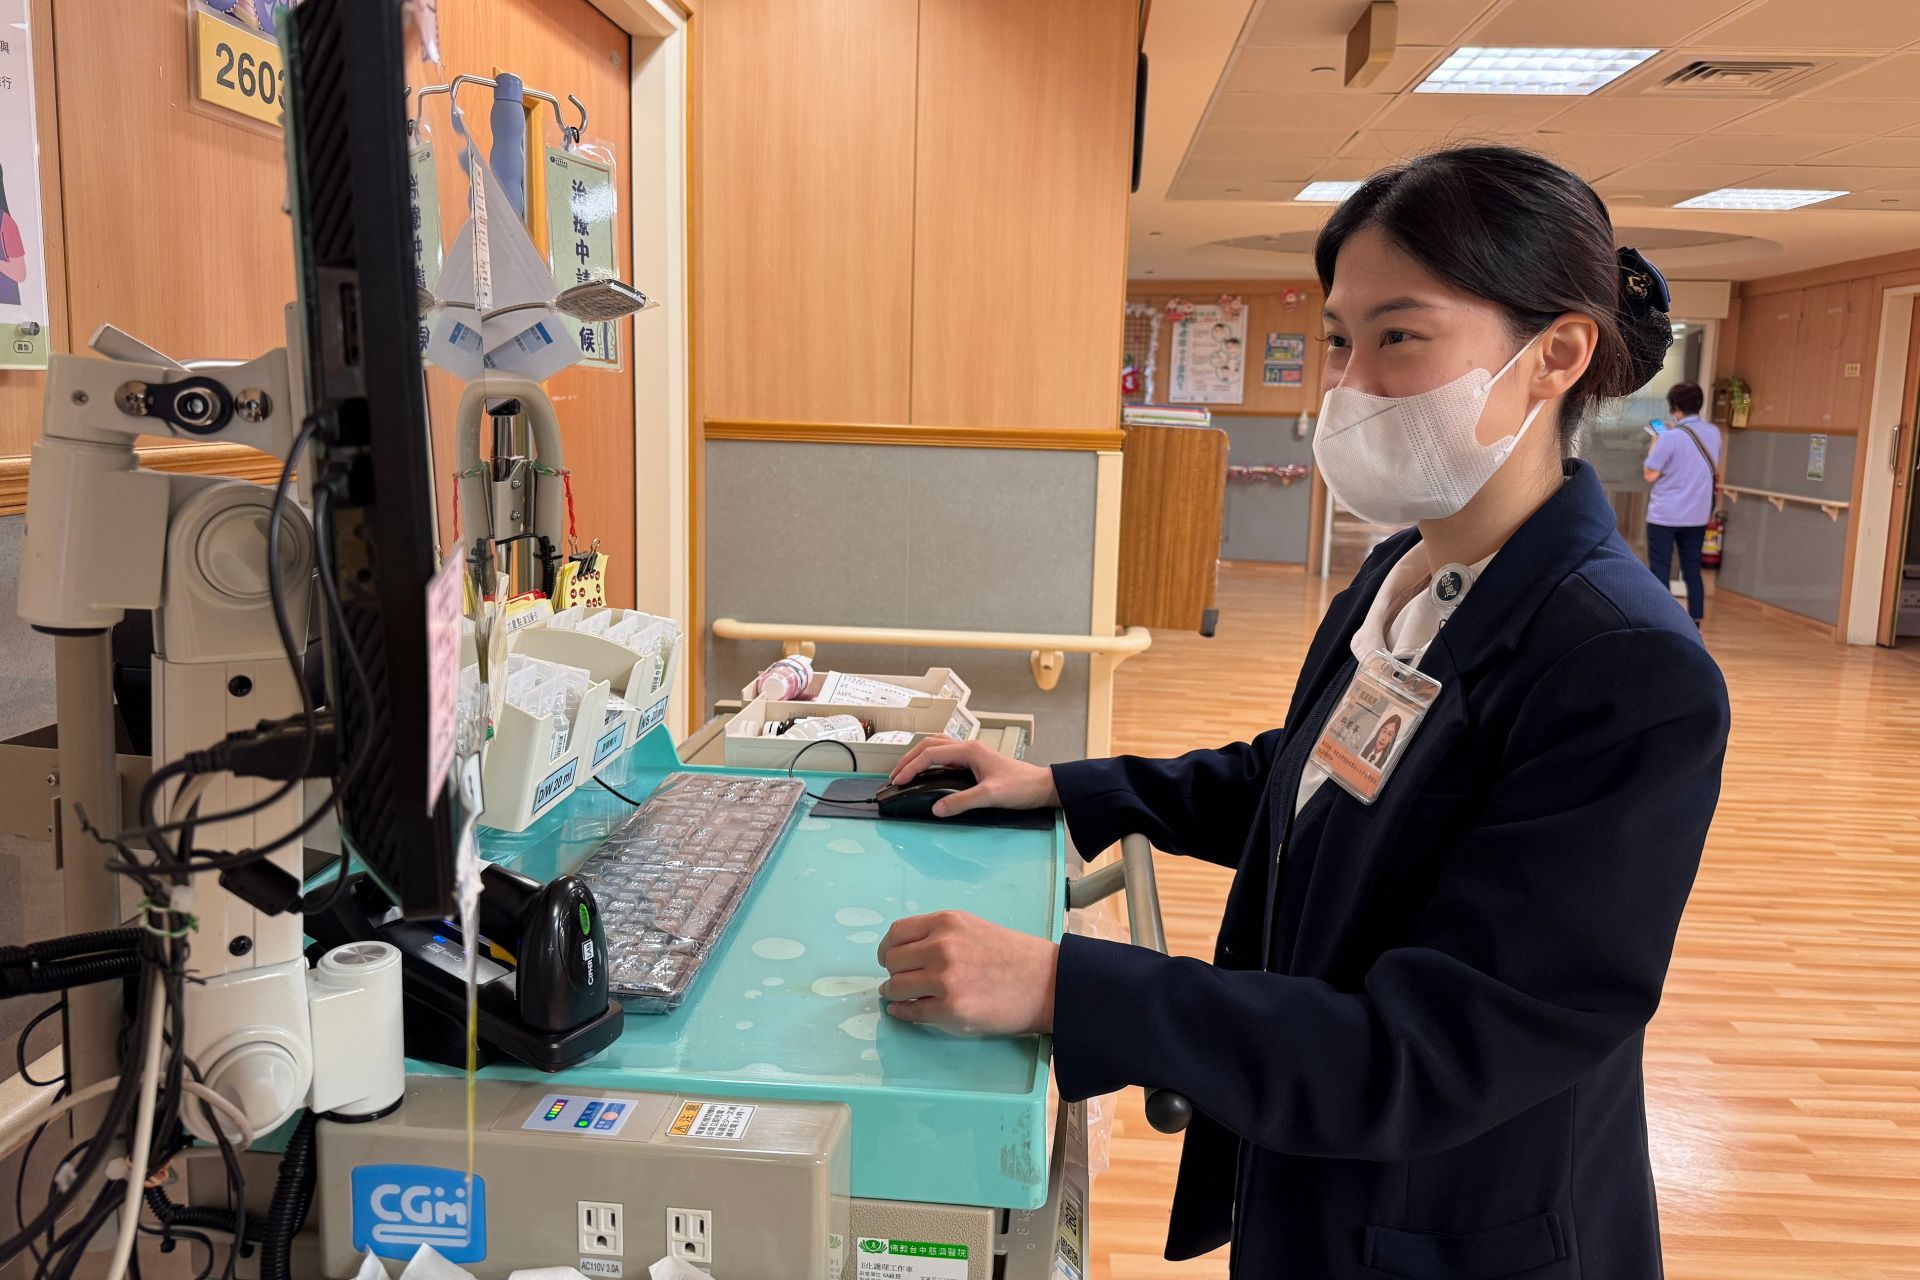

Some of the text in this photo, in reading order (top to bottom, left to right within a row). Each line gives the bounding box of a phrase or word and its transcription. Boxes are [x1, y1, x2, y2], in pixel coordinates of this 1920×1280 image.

[553, 774, 563, 792] 20
[563, 768, 573, 785] ml
[1065, 1200, 1078, 1236] 2601
[581, 1261, 620, 1274] AC110V 3.0A
